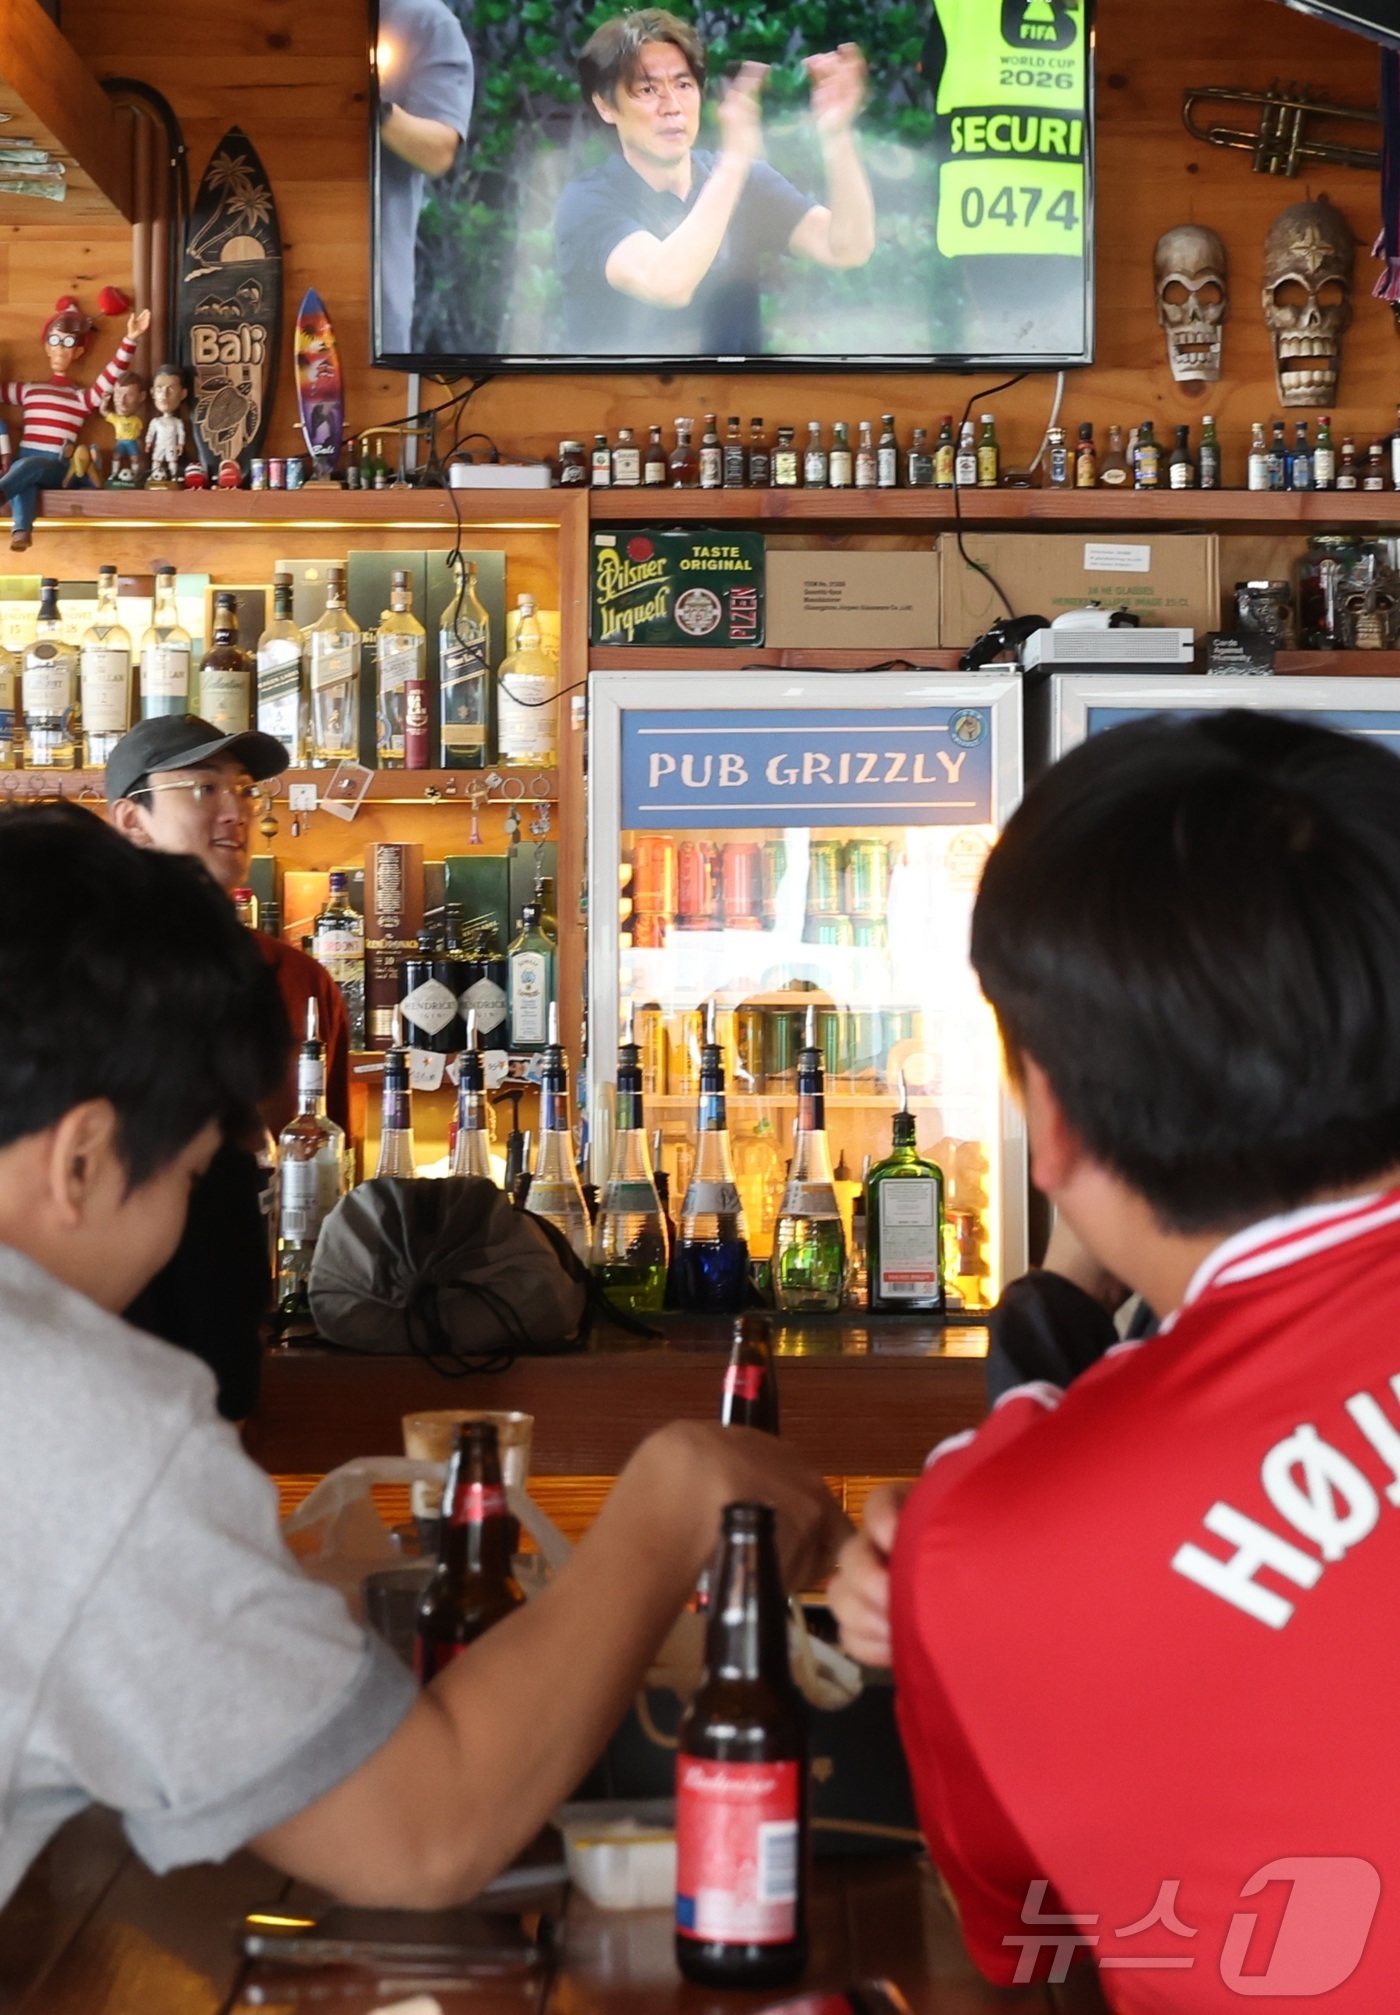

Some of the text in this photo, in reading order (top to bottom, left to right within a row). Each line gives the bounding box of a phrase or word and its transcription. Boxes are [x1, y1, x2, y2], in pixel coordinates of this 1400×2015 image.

[1020, 24, 1057, 41] FIFA
[1000, 56, 1075, 68] WORLD CUP
[1000, 70, 1074, 89] 2026
[951, 115, 1082, 156] SECURI
[961, 186, 1079, 230] 0474
[191, 324, 266, 366] Bali
[679, 559, 752, 571] ORIGINAL
[692, 546, 740, 558] TASTE
[597, 547, 667, 604] Pilsner
[600, 585, 671, 642] Urquell
[649, 751, 967, 788] PUB GRIZZLY
